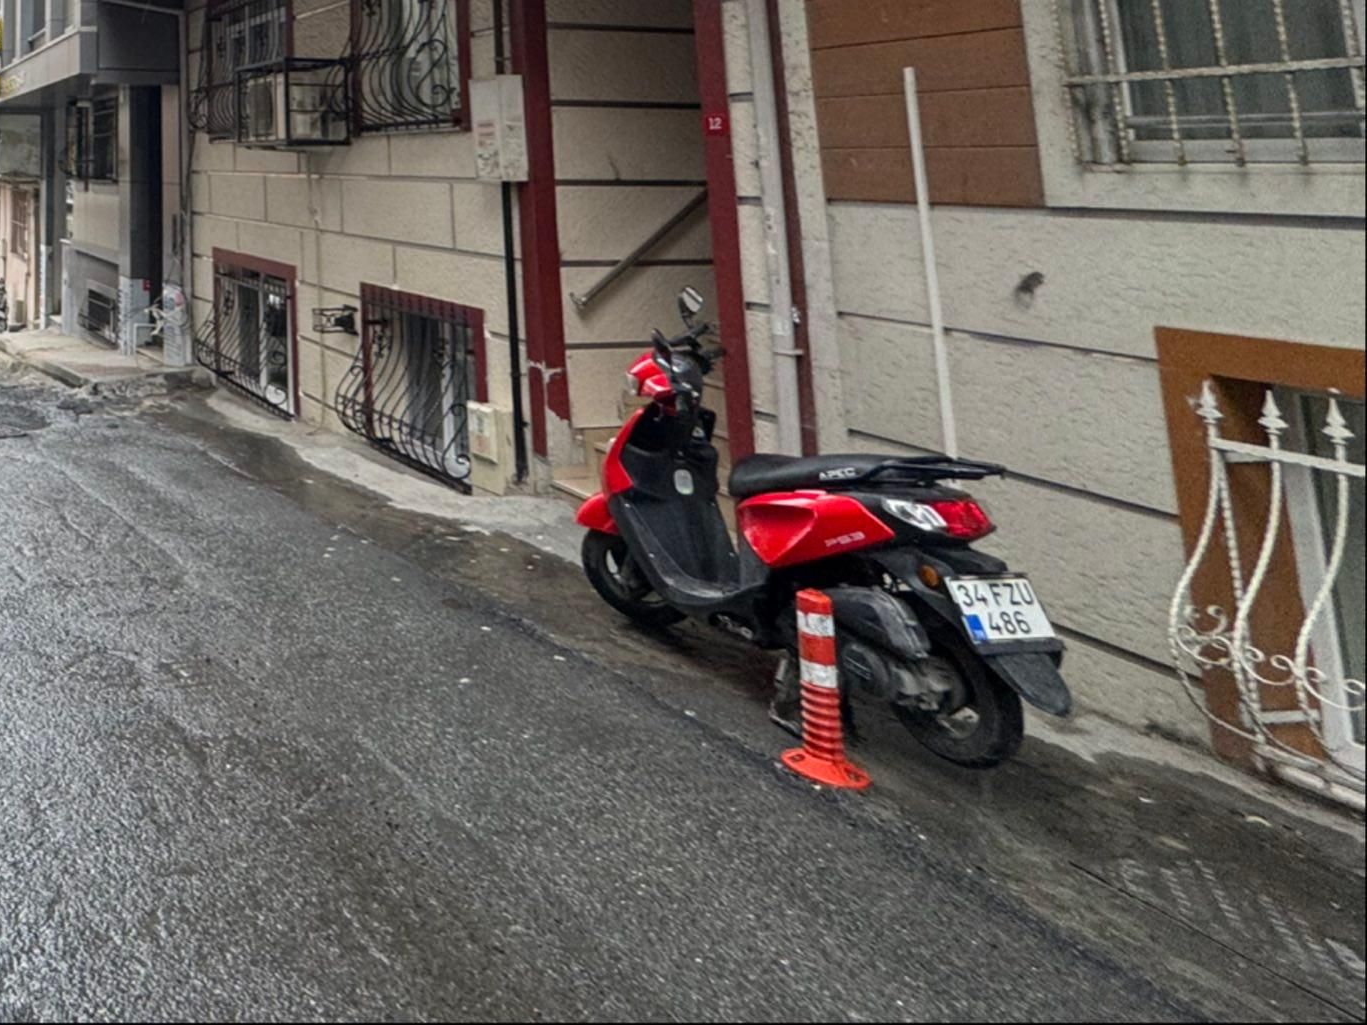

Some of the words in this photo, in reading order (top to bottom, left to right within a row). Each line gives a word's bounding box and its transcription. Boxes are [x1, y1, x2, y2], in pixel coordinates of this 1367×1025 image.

[708, 117, 722, 130] 12
[957, 583, 988, 607] 34
[989, 582, 1034, 606] FZU
[987, 610, 1031, 635] 486
